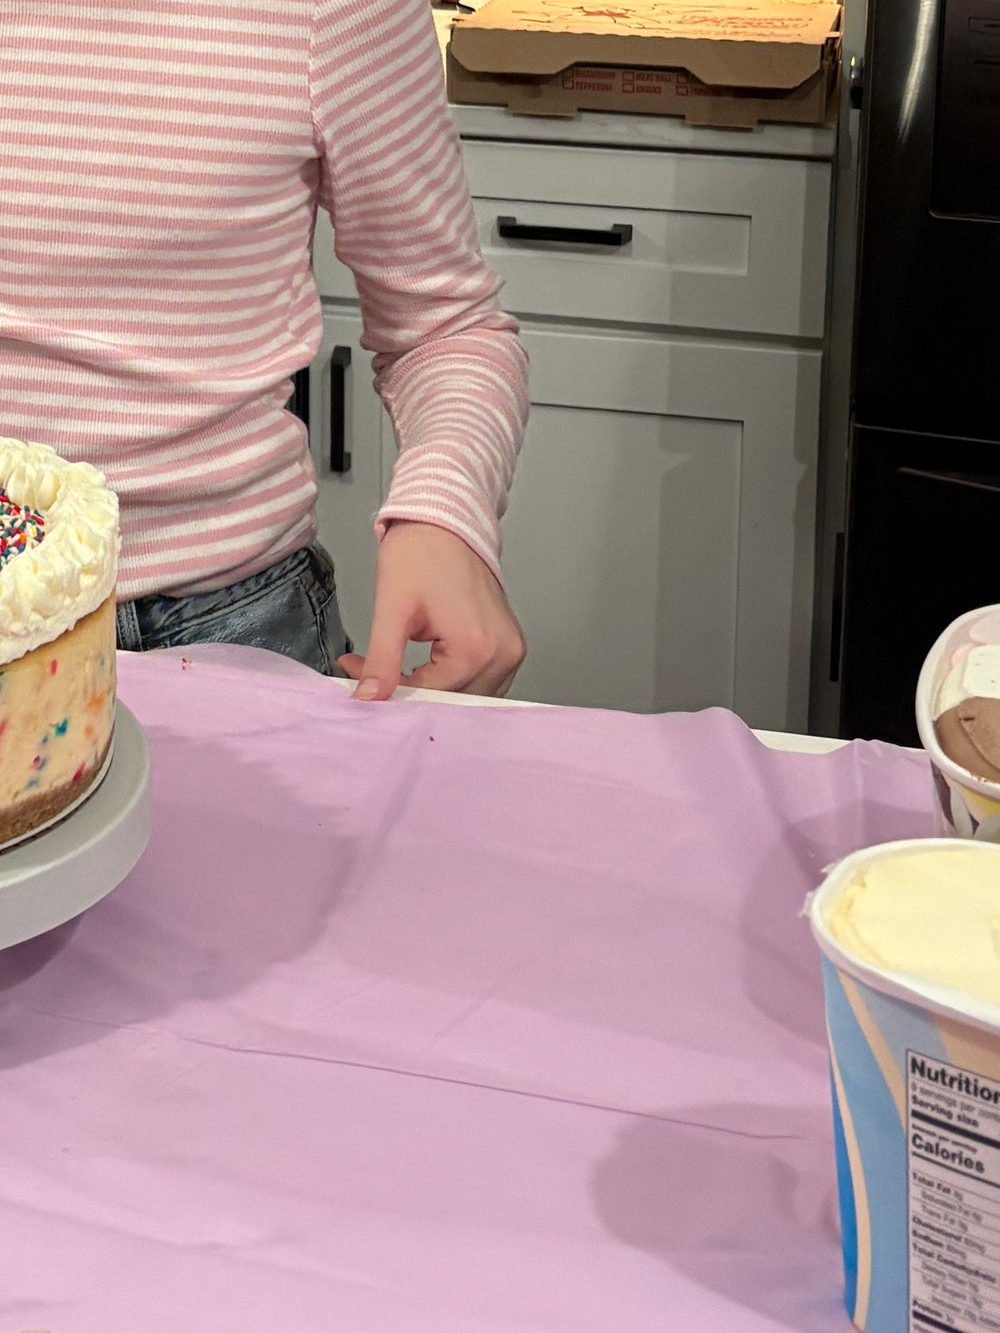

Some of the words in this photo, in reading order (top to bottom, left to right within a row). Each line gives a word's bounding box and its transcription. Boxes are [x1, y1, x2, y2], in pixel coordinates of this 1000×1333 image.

[911, 1094, 954, 1121] Serving
[957, 1114, 979, 1127] size
[911, 1133, 985, 1174] Calories
